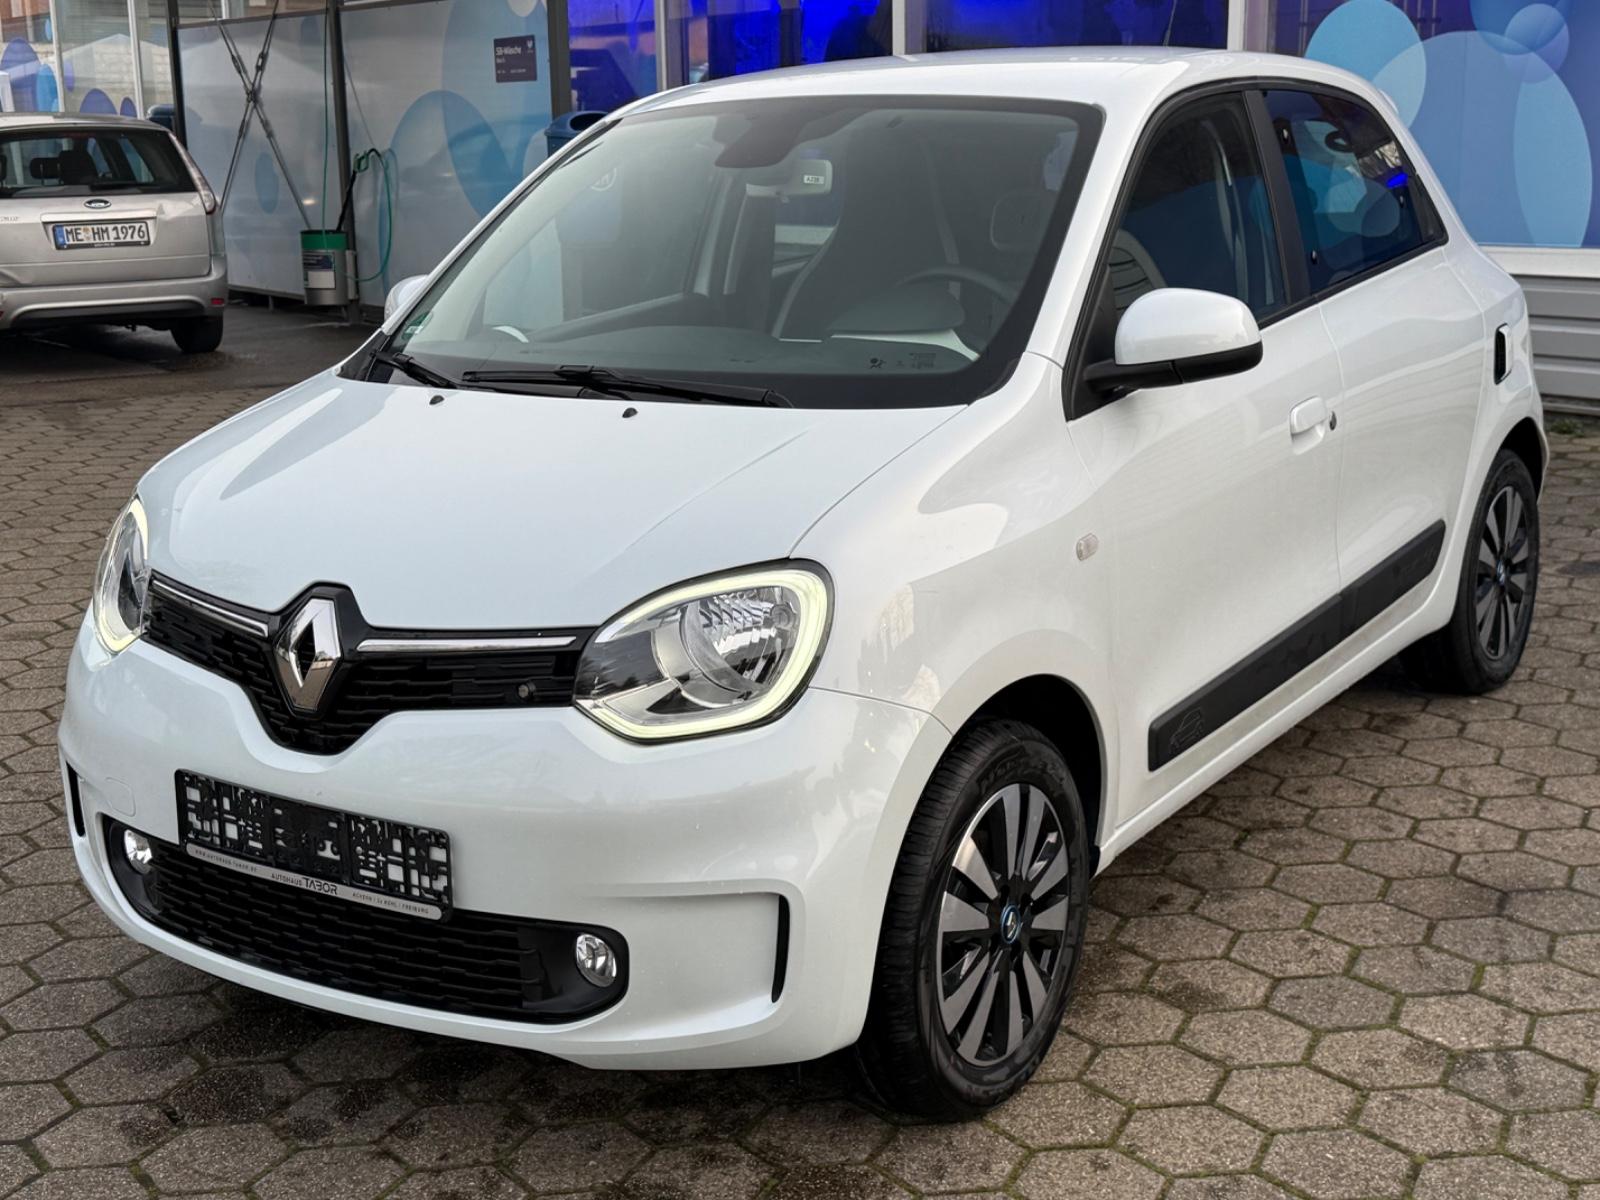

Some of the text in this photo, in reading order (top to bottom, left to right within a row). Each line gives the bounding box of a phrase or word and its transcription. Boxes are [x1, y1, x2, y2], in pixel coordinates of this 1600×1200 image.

[65, 224, 146, 242] ME HM 1976
[271, 873, 338, 895] AUTOHAUS TABOR
